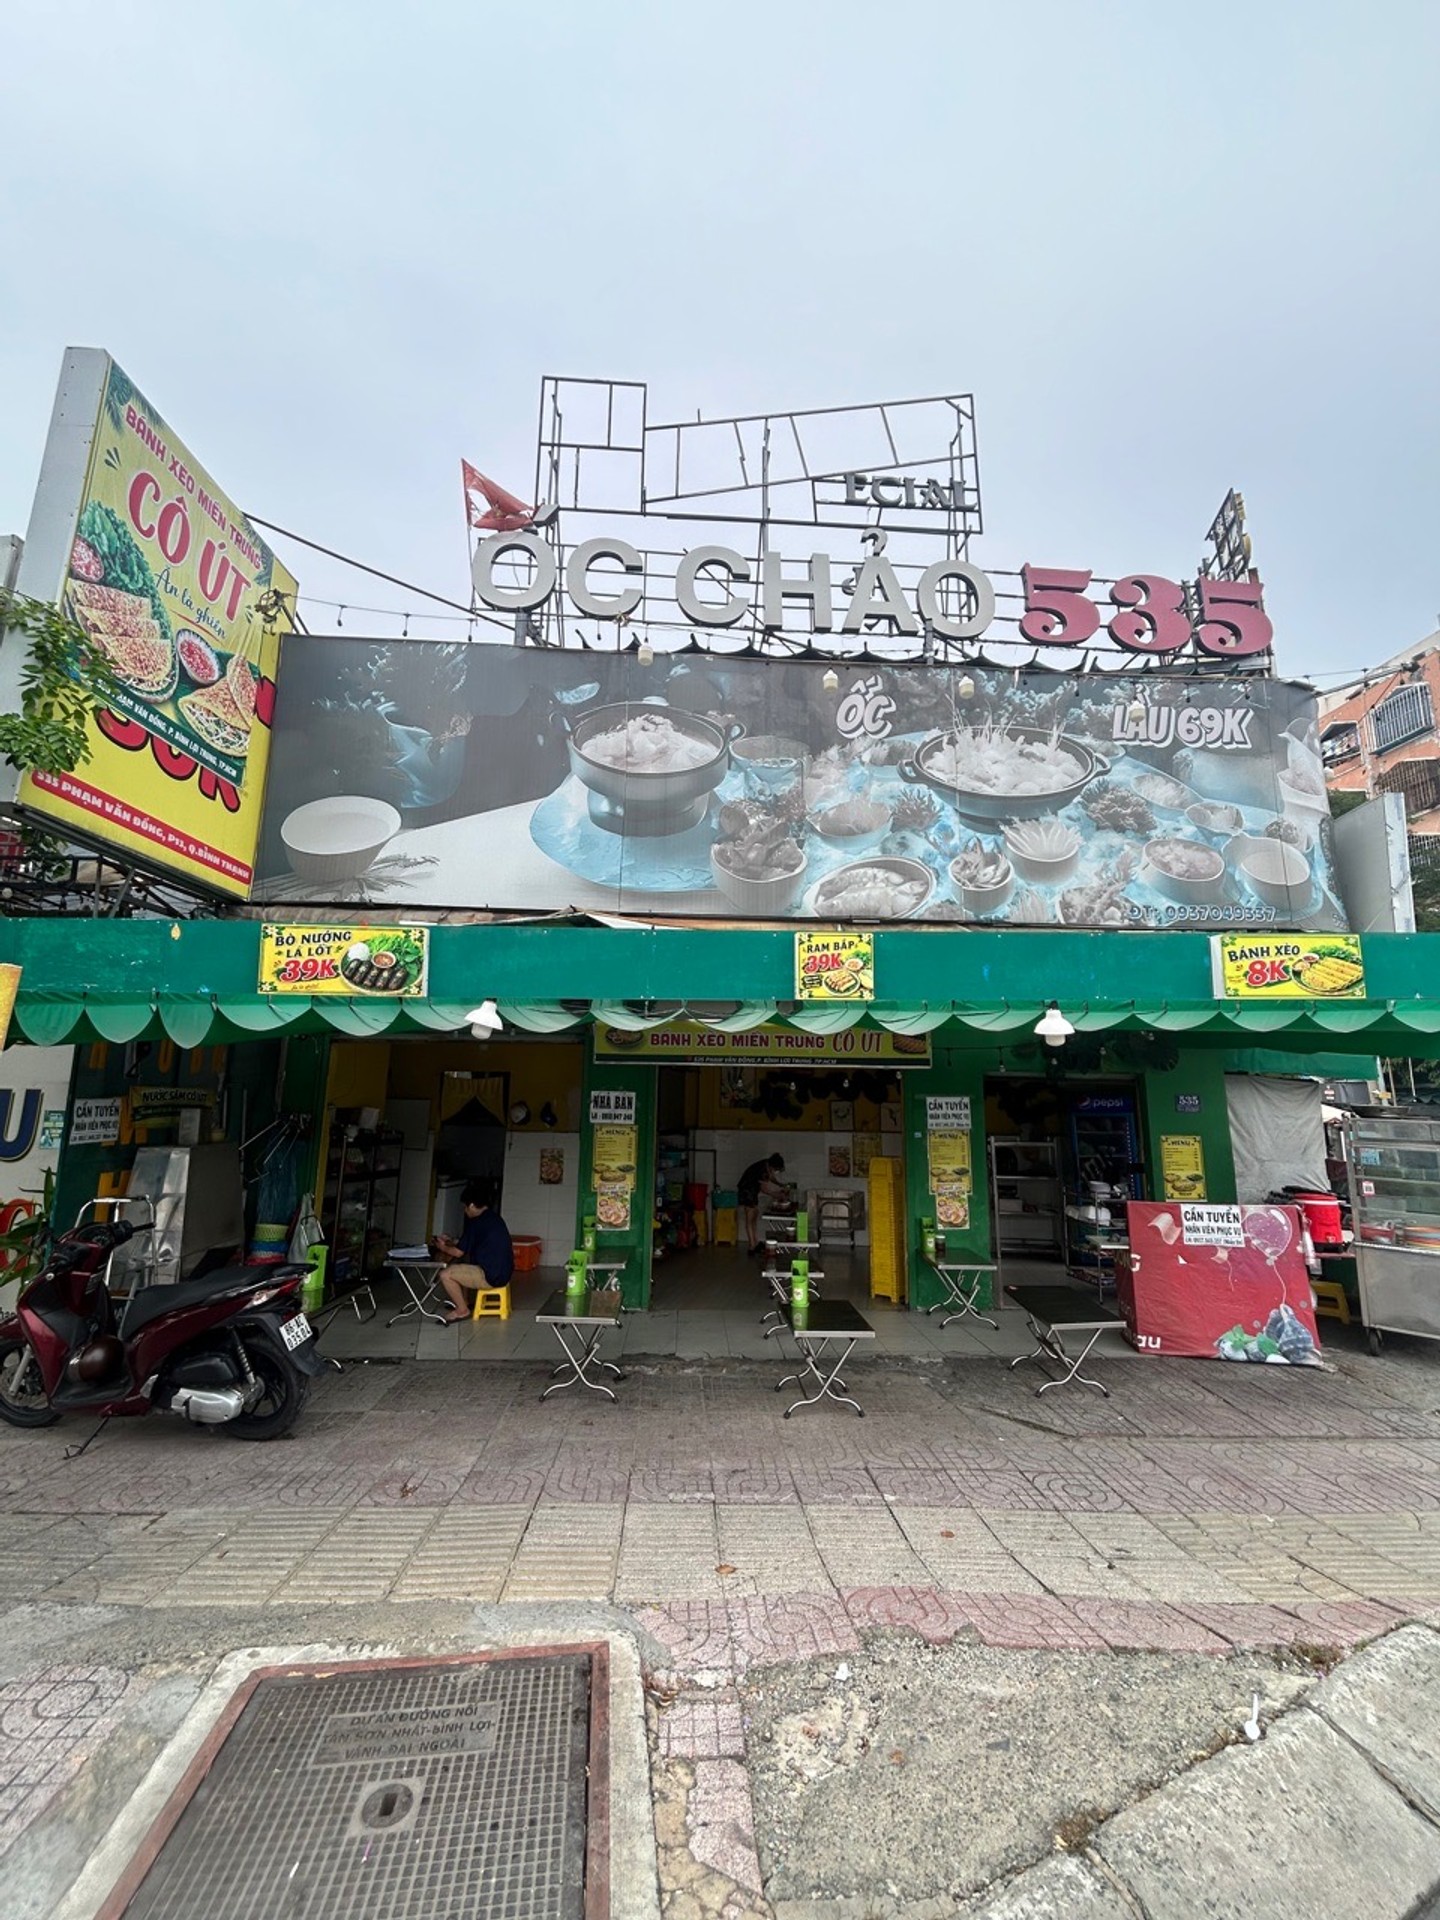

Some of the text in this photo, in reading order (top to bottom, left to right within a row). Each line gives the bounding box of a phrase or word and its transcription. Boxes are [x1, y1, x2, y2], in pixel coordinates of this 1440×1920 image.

[125, 404, 167, 461] BÁNH
[230, 524, 263, 571] TRUNG
[129, 472, 252, 622] CÔ ÚT
[675, 527, 997, 638] CHẢO
[1018, 562, 1274, 656] 535
[836, 674, 897, 740] ỐC
[1177, 707, 1254, 750] 69K
[61, 781, 101, 809] PHẠM
[104, 801, 130, 823] VĂN
[1129, 904, 1161, 920] ĐT:
[275, 931, 352, 947] BÒ NƯỚNG
[807, 943, 830, 953] RAM
[286, 946, 302, 958] LÁ
[804, 953, 842, 974] 39K
[1227, 943, 1300, 962] BÁNH XÈO
[279, 958, 337, 983] 39K
[1246, 959, 1289, 987] 8K
[650, 1030, 691, 1046] BÁNH
[775, 1035, 825, 1048] TRUNG
[832, 1029, 855, 1052] CÔ
[1093, 1097, 1123, 1107] pepsi
